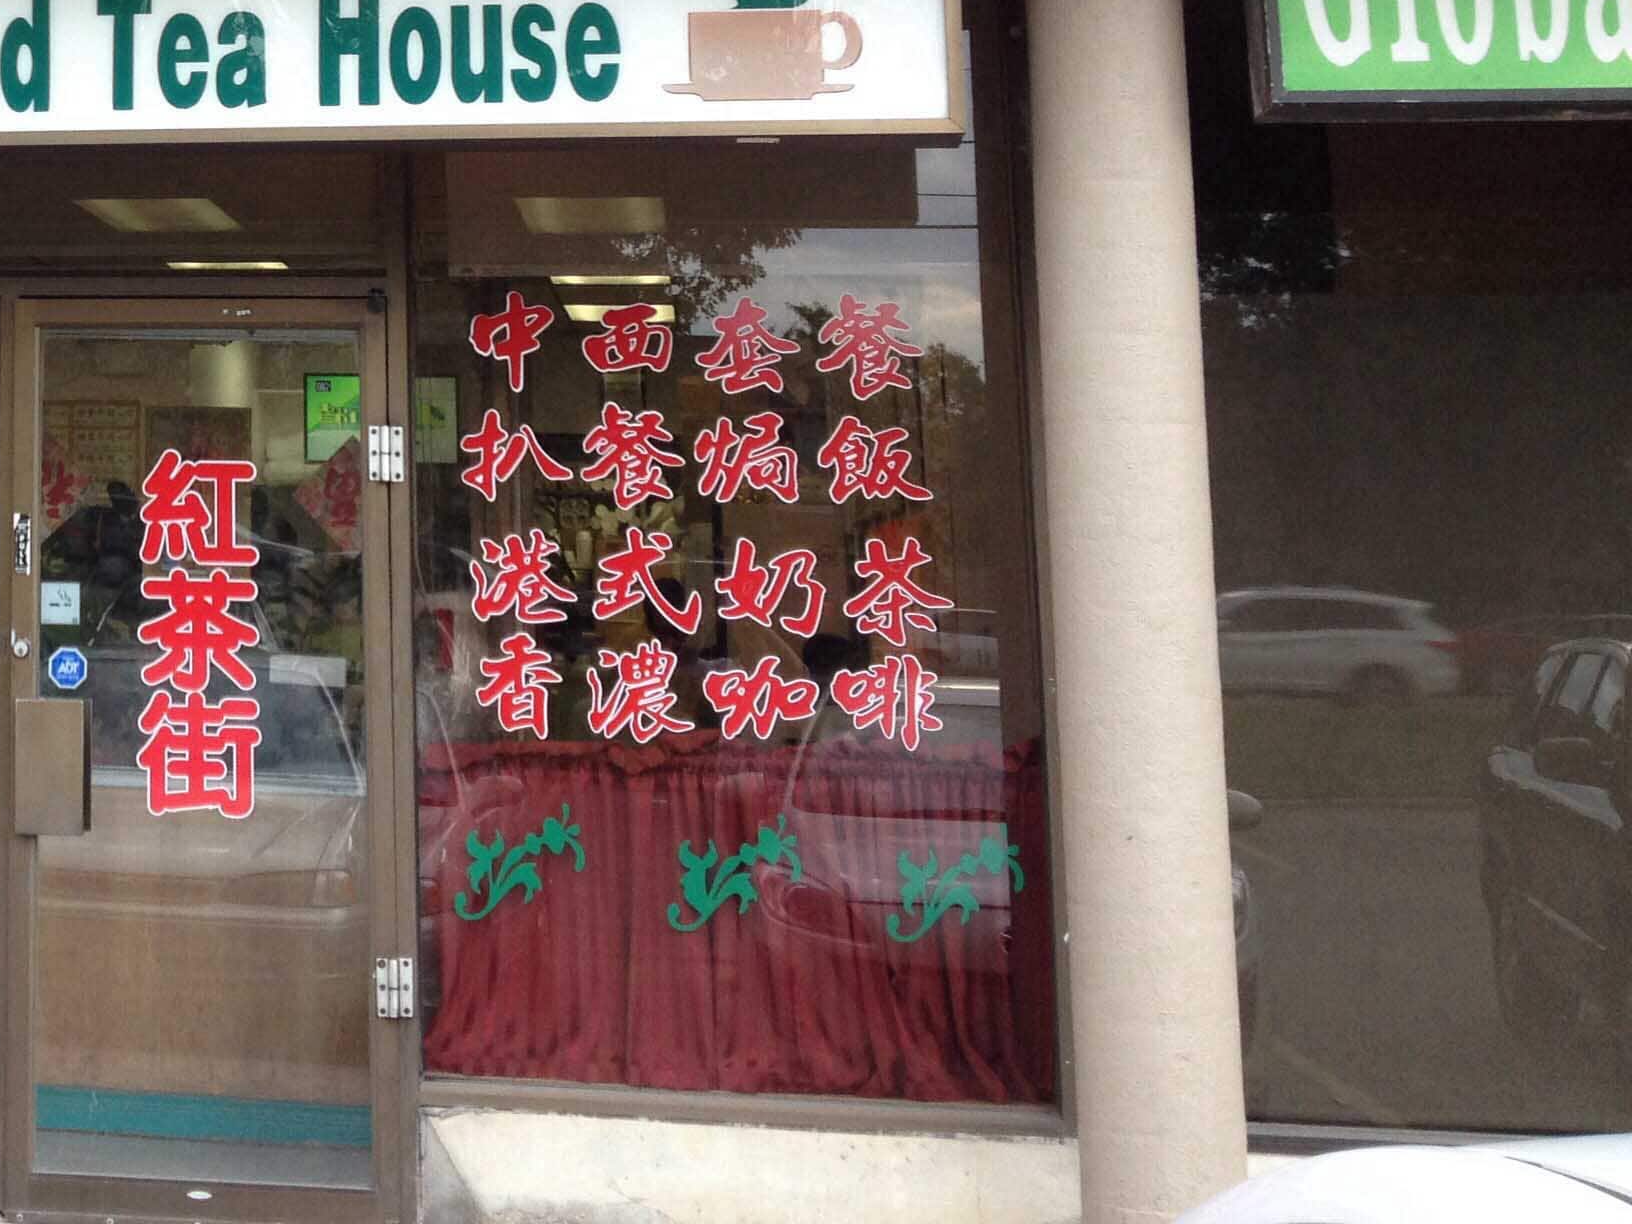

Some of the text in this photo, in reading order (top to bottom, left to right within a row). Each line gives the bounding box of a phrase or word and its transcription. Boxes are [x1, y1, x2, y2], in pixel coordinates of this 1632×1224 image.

[469, 291, 923, 400] 中西套餐
[461, 402, 934, 510] 扒餐焗飯
[137, 448, 261, 819] 紅茶街
[470, 528, 954, 646] 港式奶茶
[58, 662, 80, 674] ADT
[475, 632, 943, 751] 香濃咖啡
